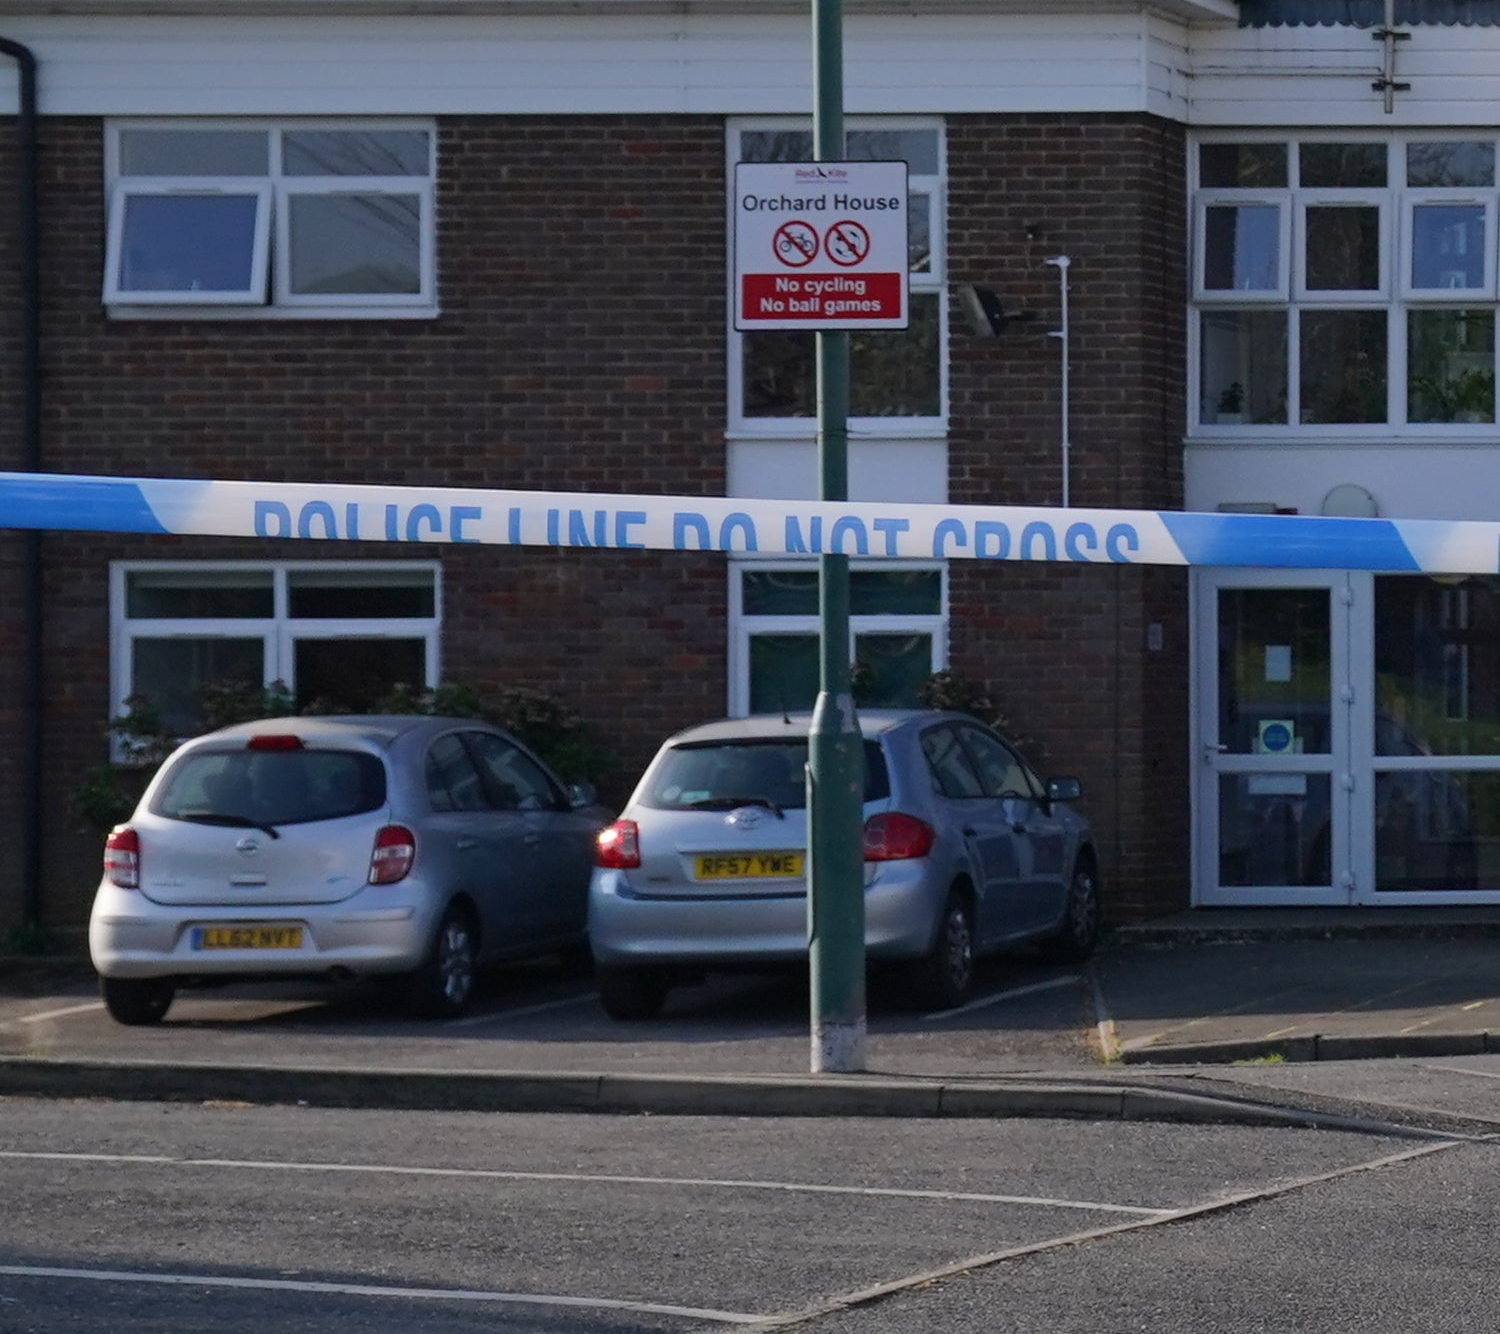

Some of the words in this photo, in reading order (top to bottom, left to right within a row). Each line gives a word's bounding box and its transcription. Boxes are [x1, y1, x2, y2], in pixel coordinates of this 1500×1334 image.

[742, 195, 826, 211] Orchard
[834, 194, 899, 211] House
[775, 278, 799, 292] No
[804, 278, 866, 295] cycling
[760, 298, 784, 312] No
[789, 298, 819, 312] ball
[825, 301, 881, 314] games
[254, 500, 482, 543] POLICE
[508, 507, 647, 549] LINE
[673, 512, 758, 554] DO
[785, 515, 910, 558] NOT
[932, 518, 1140, 563] CROSS
